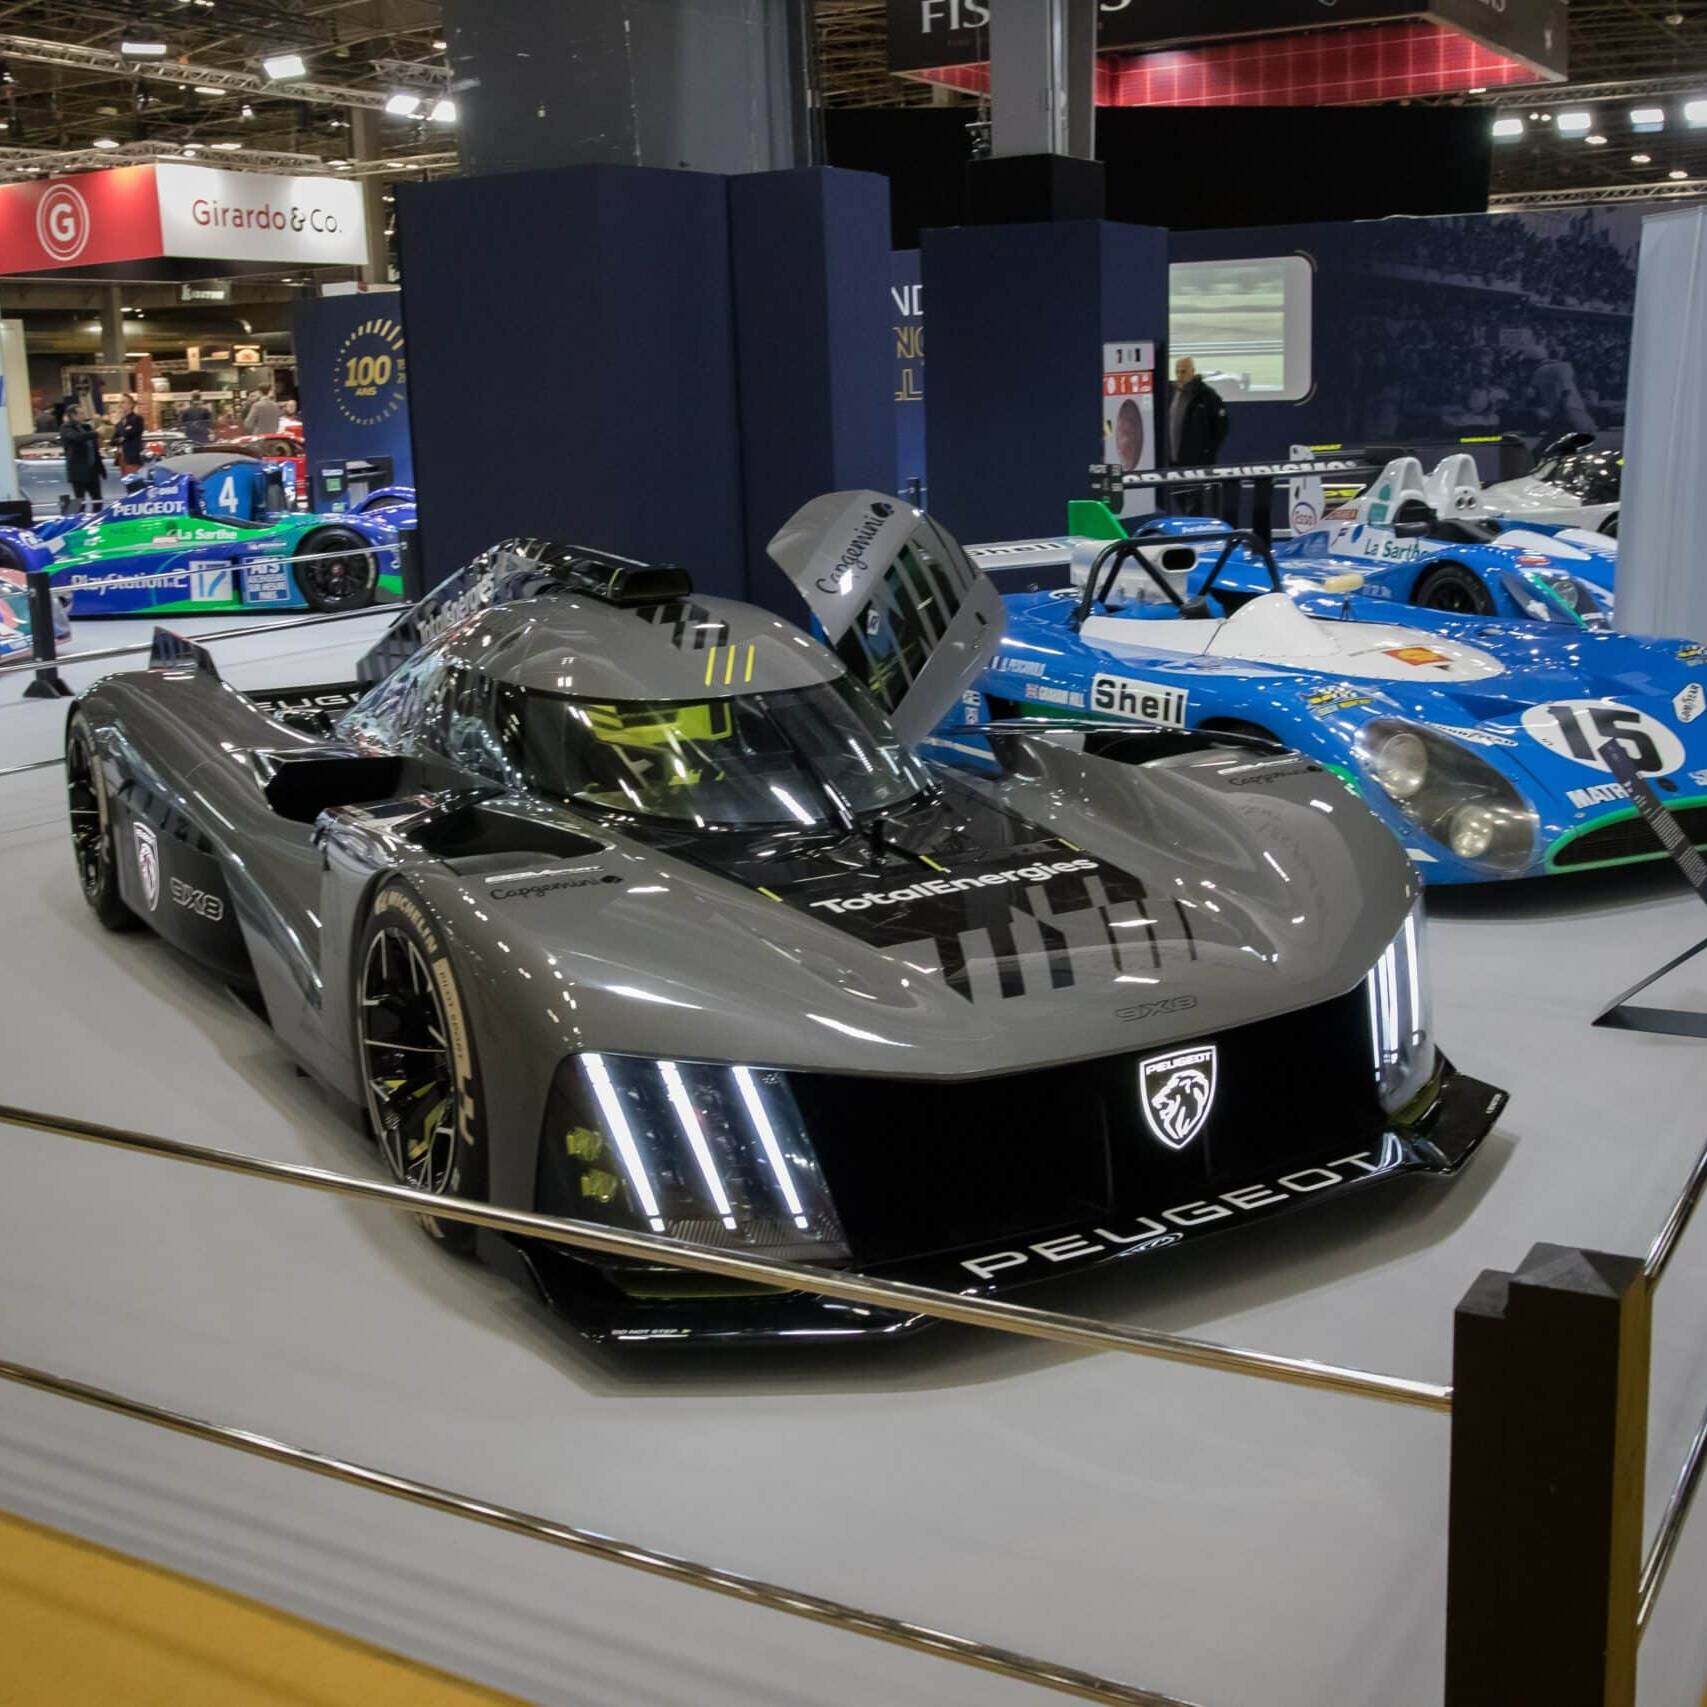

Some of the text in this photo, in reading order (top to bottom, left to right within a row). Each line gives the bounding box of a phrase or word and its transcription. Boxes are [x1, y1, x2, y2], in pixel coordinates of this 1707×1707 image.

[50, 203, 76, 242] G
[192, 199, 287, 230] Girardo
[344, 355, 392, 387] 100
[112, 500, 184, 518] PEUGEOT
[218, 476, 239, 514] 4
[1363, 538, 1380, 556] La
[1095, 677, 1185, 725] Shell
[1546, 705, 1664, 773] 15
[169, 875, 225, 922] 9X8
[489, 878, 602, 901] Capgemini
[808, 858, 1100, 914] TotalEnergies
[1113, 994, 1198, 1022] 9X8
[1144, 1050, 1212, 1076] PEUGEOT
[960, 1151, 1374, 1281] PEUGEOT
